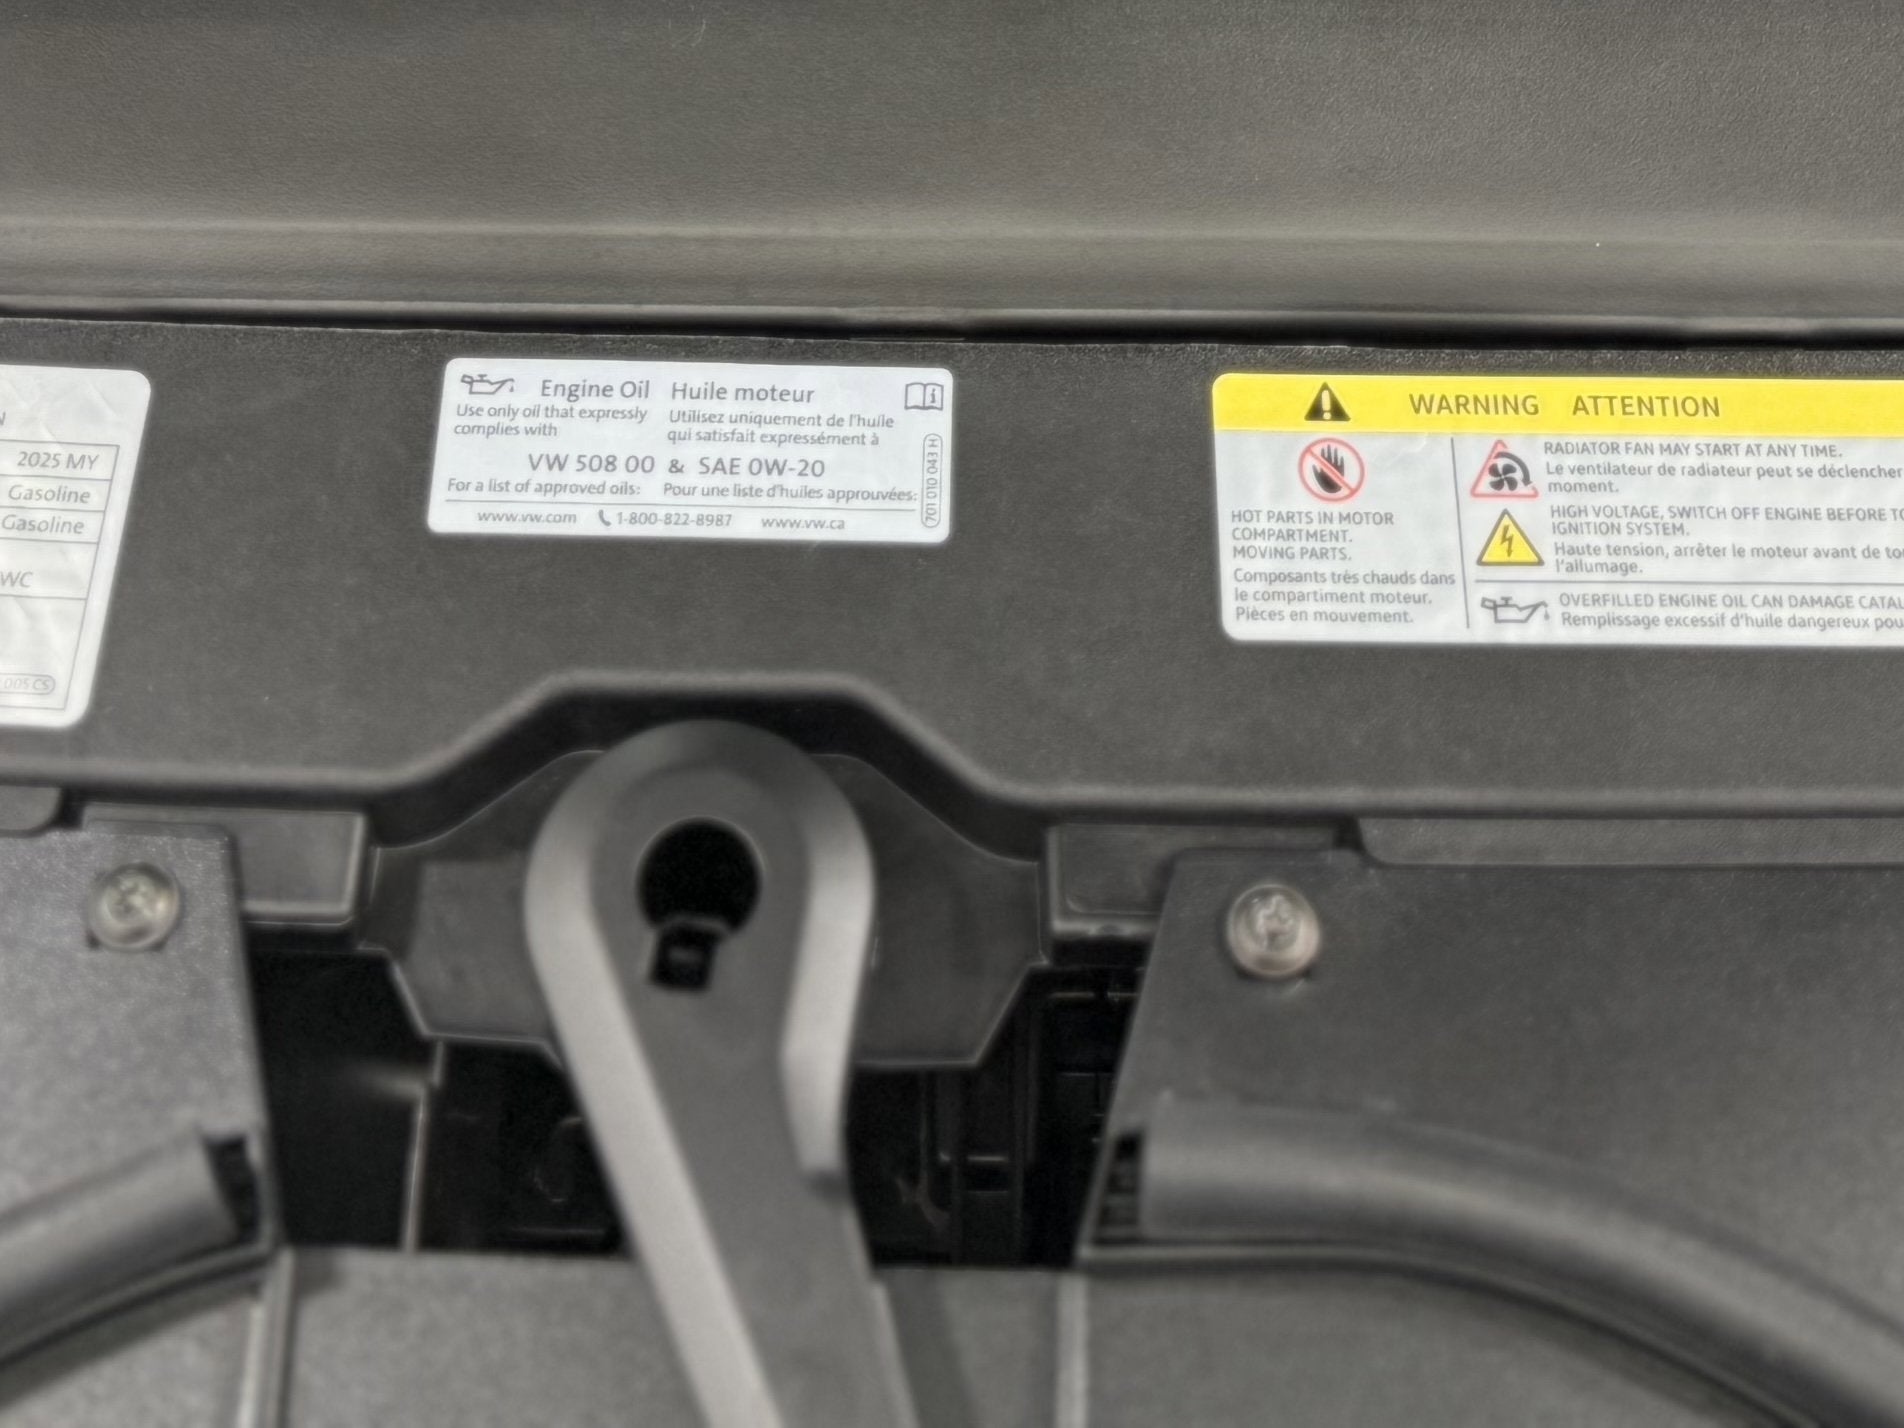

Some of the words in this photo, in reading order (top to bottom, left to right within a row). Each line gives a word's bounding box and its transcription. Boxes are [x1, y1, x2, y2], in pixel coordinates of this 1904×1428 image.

[540, 379, 615, 403] Engine
[619, 379, 651, 399] Oil
[670, 381, 728, 402] Huile
[734, 384, 816, 404] moteur
[456, 403, 485, 418] Use
[487, 403, 520, 423] only
[522, 403, 542, 419] oil
[544, 404, 576, 419] that
[578, 405, 649, 425] expressly
[1409, 393, 1540, 418] WARNING
[1572, 395, 1721, 419] ATTENTION
[453, 420, 521, 439] complies
[524, 422, 558, 437] with
[669, 409, 726, 425] Utilisez
[728, 411, 823, 432] uniquement
[825, 412, 846, 428] de
[666, 427, 692, 445] qui
[694, 427, 757, 444] satisfait
[759, 429, 866, 448] expressément
[1544, 441, 1621, 456] RADIATOR
[1624, 442, 1655, 456] FAN
[1658, 442, 1691, 457] MAY
[1694, 442, 1741, 457] START
[1744, 443, 1763, 457] AT
[1766, 443, 1797, 458] ANY
[1800, 443, 1844, 458] TIME.
[17, 450, 62, 470] 2025
[65, 452, 100, 471] MY
[527, 453, 570, 472] VW
[575, 454, 618, 473] 508
[624, 455, 656, 474] 00
[667, 458, 686, 474] &
[698, 456, 742, 476] SAE
[748, 457, 826, 478] 0W-20
[1545, 461, 1564, 476] Le
[1567, 461, 1654, 476] ventilateur
[1657, 462, 1677, 477] de
[1681, 462, 1753, 478] radiateur
[1756, 465, 1793, 480] peut
[1796, 466, 1814, 479] se
[1817, 464, 1904, 479] déclencher
[7, 483, 92, 506] Gasoline
[447, 477, 473, 493] For
[488, 478, 511, 493] list
[514, 479, 532, 494] of
[534, 480, 606, 498] approved
[609, 481, 642, 496] oils:
[663, 482, 699, 499] Pour
[700, 486, 731, 499] une
[732, 483, 765, 499] liste
[827, 485, 918, 504] approuvées:
[1547, 480, 1620, 494] moment.
[477, 510, 578, 524] www.vw.com
[616, 510, 733, 528] 1-800-822-8987
[761, 515, 846, 530] www.vw.ca
[1231, 509, 1263, 524] HOT
[1266, 510, 1314, 525] PARTS
[1317, 511, 1335, 525] IN
[1338, 511, 1395, 526] MOTOR
[1550, 504, 1588, 519] HIGH
[1592, 505, 1665, 521] VOLTAGE,
[1668, 505, 1727, 520] SWITCH
[1731, 506, 1761, 521] OFF
[1764, 507, 1823, 522] ENGINE
[1826, 508, 1888, 522] BEFORE
[1, 513, 85, 536] Gasoline
[1552, 521, 1622, 536] IGNITION
[1625, 522, 1691, 537] SYSTEM.
[1231, 527, 1353, 543] COMPARTMENT.
[1233, 545, 1296, 560] MOVING
[1299, 546, 1352, 561] PARTS.
[1554, 542, 1602, 557] Haute
[1605, 543, 1670, 560] tension,
[1673, 543, 1727, 558] arrêter
[1732, 543, 1746, 558] le
[1751, 546, 1809, 559] moteur
[1812, 546, 1858, 559] avant
[1861, 545, 1881, 559] de
[1233, 567, 1327, 586] Composants
[1330, 569, 1360, 585] très
[1362, 570, 1417, 585] chauds
[1419, 570, 1456, 585] dans
[1234, 587, 1249, 602] le
[1252, 588, 1366, 605] compartiment
[1370, 590, 1433, 605] moteur.
[1559, 592, 1655, 608] OVERFILLED
[1658, 593, 1718, 608] ENGINE
[1721, 594, 1748, 608] OIL
[1751, 594, 1784, 609] CAN
[1788, 595, 1855, 610] DAMAGE
[1235, 605, 1285, 622] Pièces
[1289, 609, 1309, 622] en
[1313, 609, 1414, 624] mouvement.
[1561, 611, 1661, 630] Remplissage
[1664, 612, 1727, 628] excessif
[1787, 614, 1870, 632] dangereux
